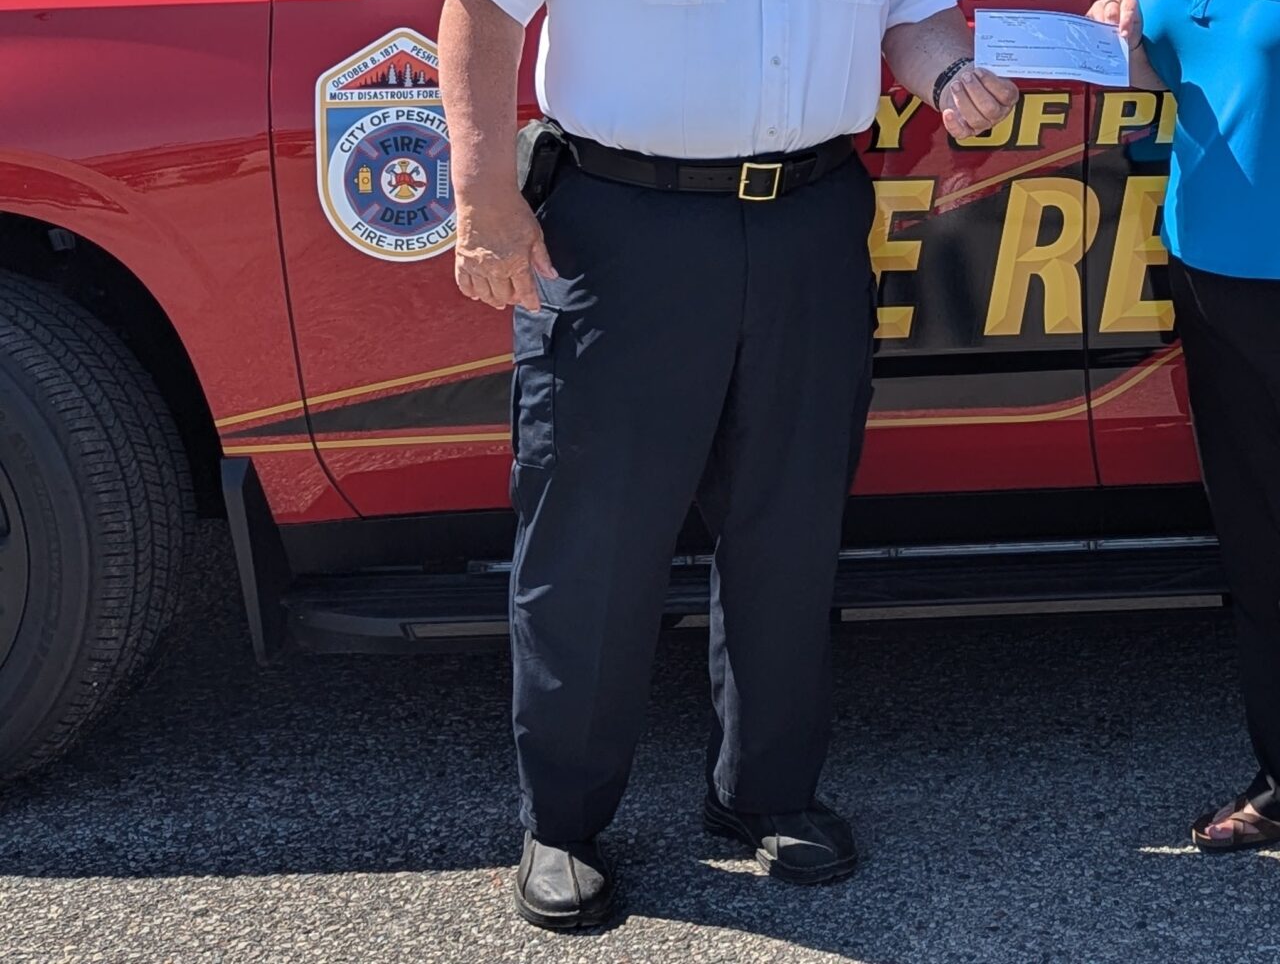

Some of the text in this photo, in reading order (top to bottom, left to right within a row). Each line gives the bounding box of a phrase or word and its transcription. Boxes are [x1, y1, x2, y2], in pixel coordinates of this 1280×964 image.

[332, 61, 369, 88] OCTOBER
[380, 43, 399, 59] 1871
[329, 92, 355, 101] MOST
[357, 90, 414, 100] DISASTROUS
[340, 109, 450, 153] CITY OF PESHTI
[379, 136, 428, 156] FIRE
[380, 205, 430, 226] DEPT
[351, 219, 457, 251] FIRE-RESCUE
